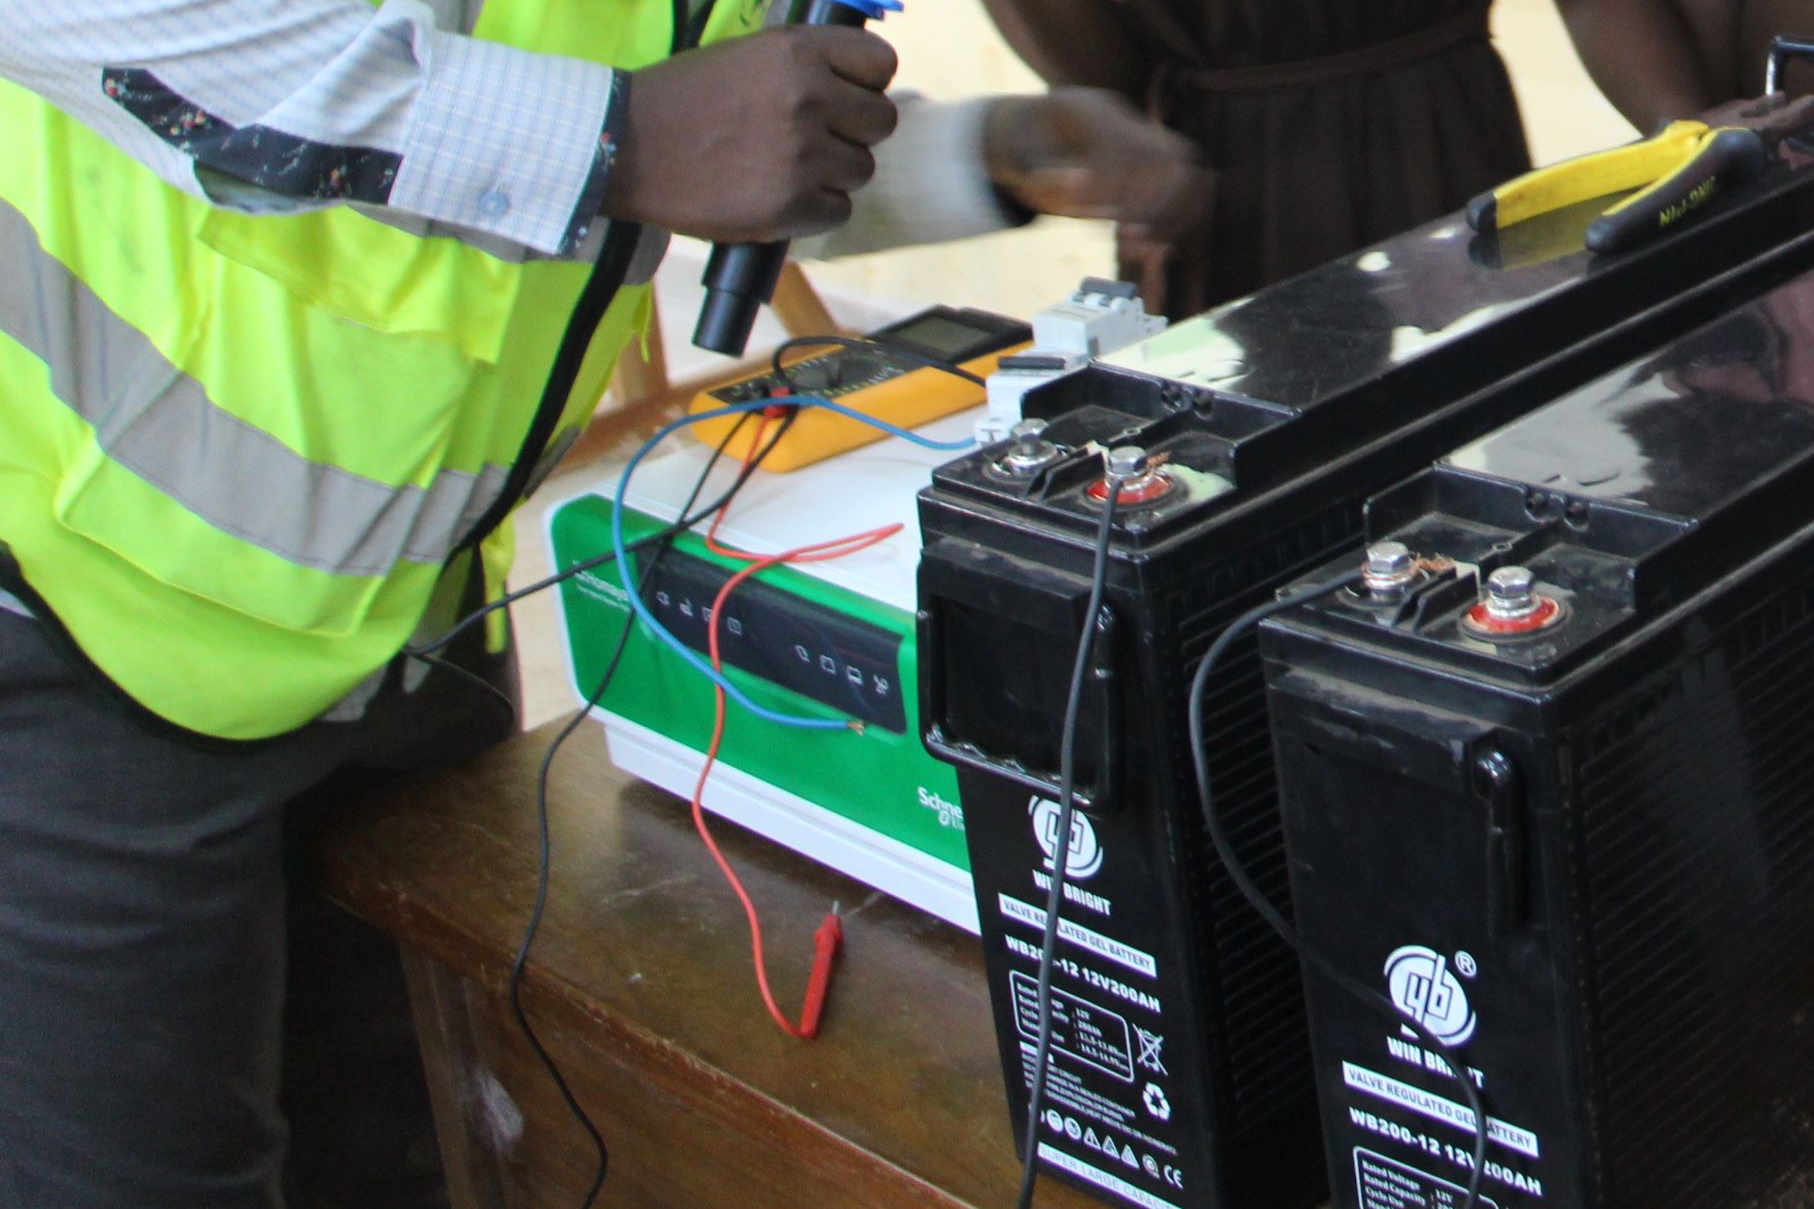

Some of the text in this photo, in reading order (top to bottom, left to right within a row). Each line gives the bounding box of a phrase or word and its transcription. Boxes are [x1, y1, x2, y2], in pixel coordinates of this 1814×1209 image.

[917, 786, 964, 819] Schne
[1063, 882, 1112, 916] BRIGHT
[1005, 900, 1150, 968] VALVE RELATED GEL BATTERY
[1082, 967, 1161, 1013] 12V200AH
[1387, 1036, 1422, 1066] WIN
[1349, 1068, 1384, 1091] VALVE
[1386, 1080, 1452, 1117] REGULATED
[1487, 1121, 1532, 1147] ATTERY
[1349, 1106, 1441, 1156] WB200-12
